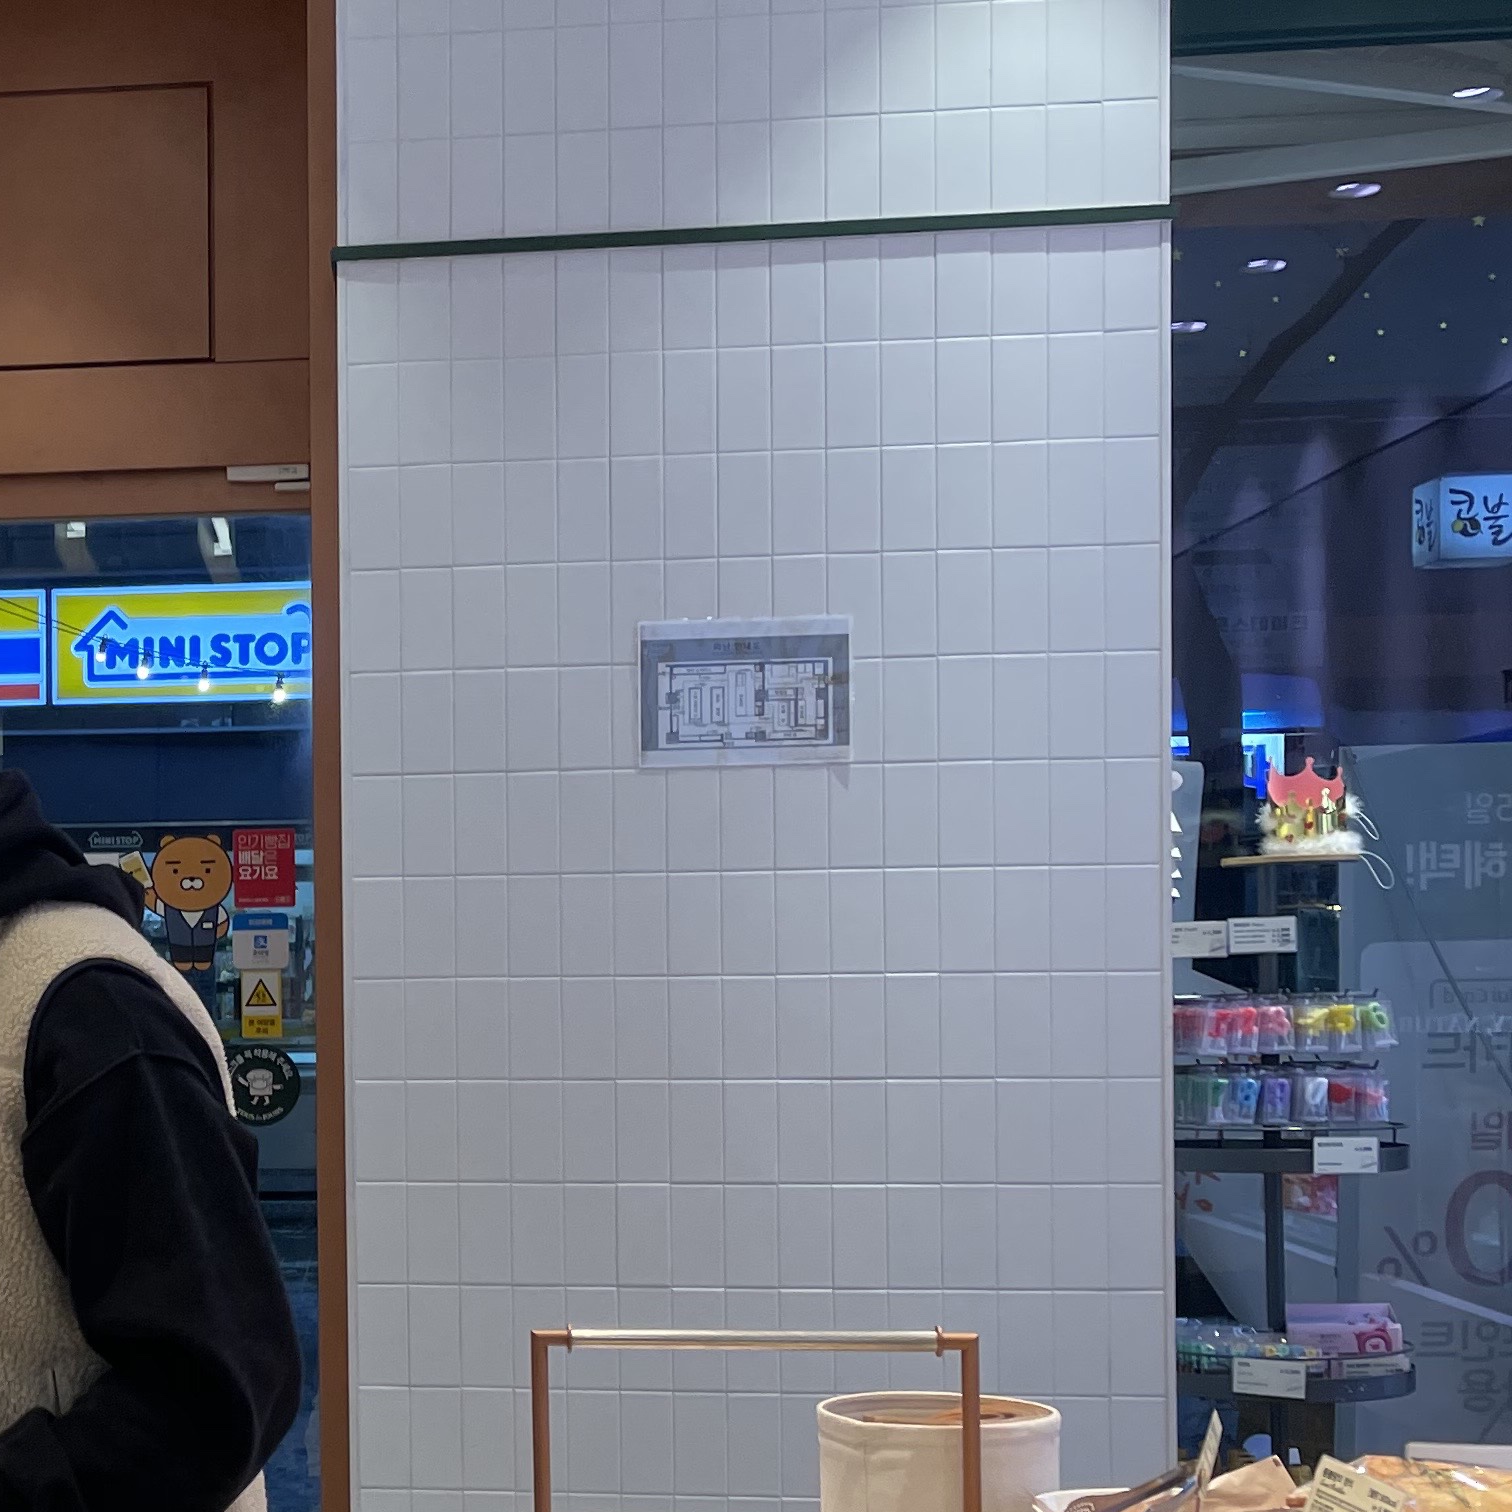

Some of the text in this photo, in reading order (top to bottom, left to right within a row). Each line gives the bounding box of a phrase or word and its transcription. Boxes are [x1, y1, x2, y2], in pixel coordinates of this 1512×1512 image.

[237, 834, 291, 850] 인기빵집
[238, 850, 277, 865] 배달은
[238, 866, 279, 880] 요기요
